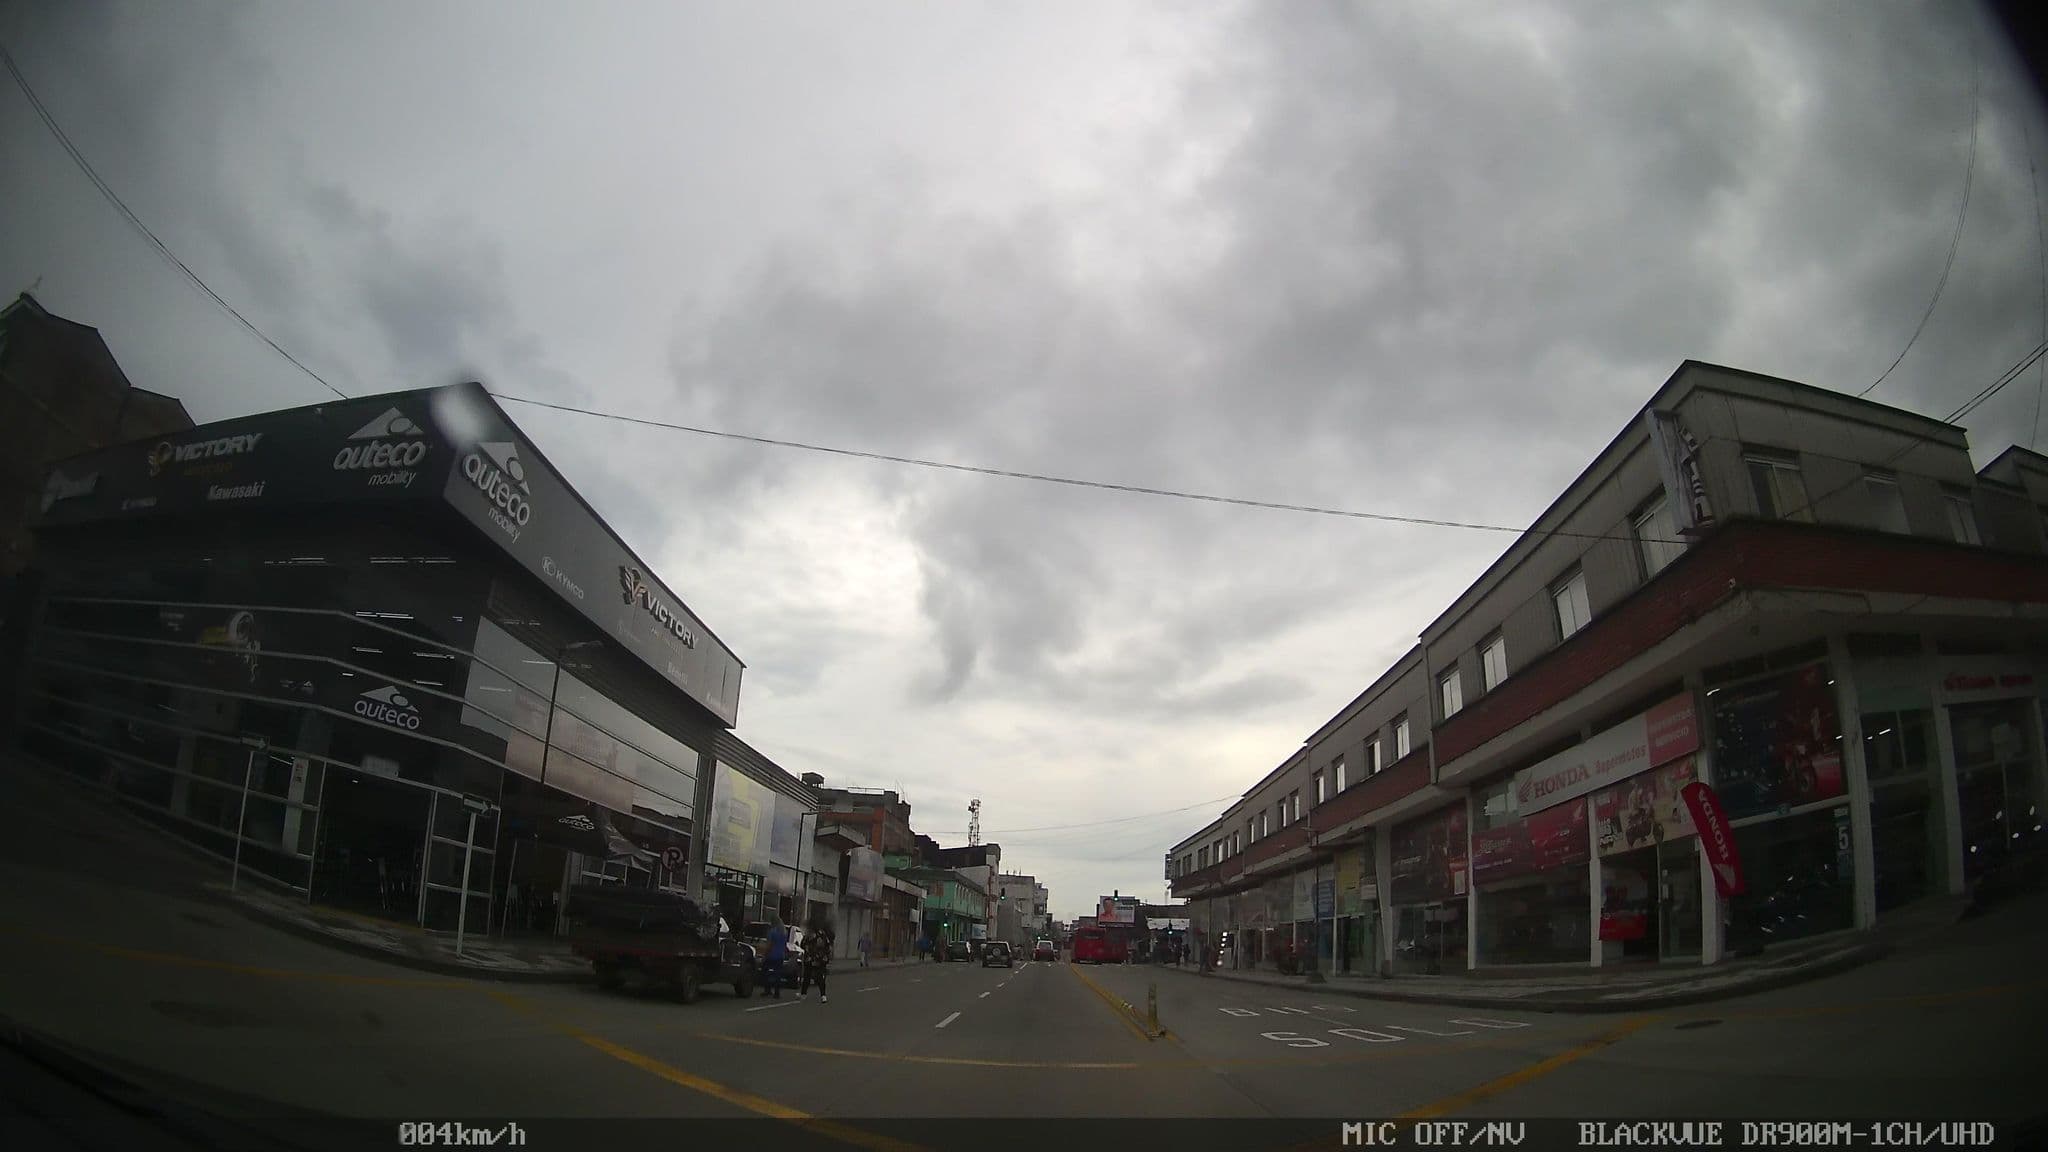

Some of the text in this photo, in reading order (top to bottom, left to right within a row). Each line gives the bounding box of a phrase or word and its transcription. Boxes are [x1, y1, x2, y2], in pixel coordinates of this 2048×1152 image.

[175, 431, 263, 463] VICTORY
[332, 439, 427, 471] auteco
[208, 480, 266, 501] Kawasaki
[367, 470, 417, 489] mobility
[463, 453, 530, 526] auteco
[487, 506, 521, 544] mobility
[555, 569, 585, 600] KYMCO
[646, 594, 699, 651] VICTORY
[354, 700, 420, 730] auteco
[1533, 766, 1590, 799] HONDA
[558, 817, 595, 831] auteco
[1698, 788, 1730, 861] HONDA
[1838, 826, 1849, 850] 5
[1260, 1018, 1533, 1048] SOLO
